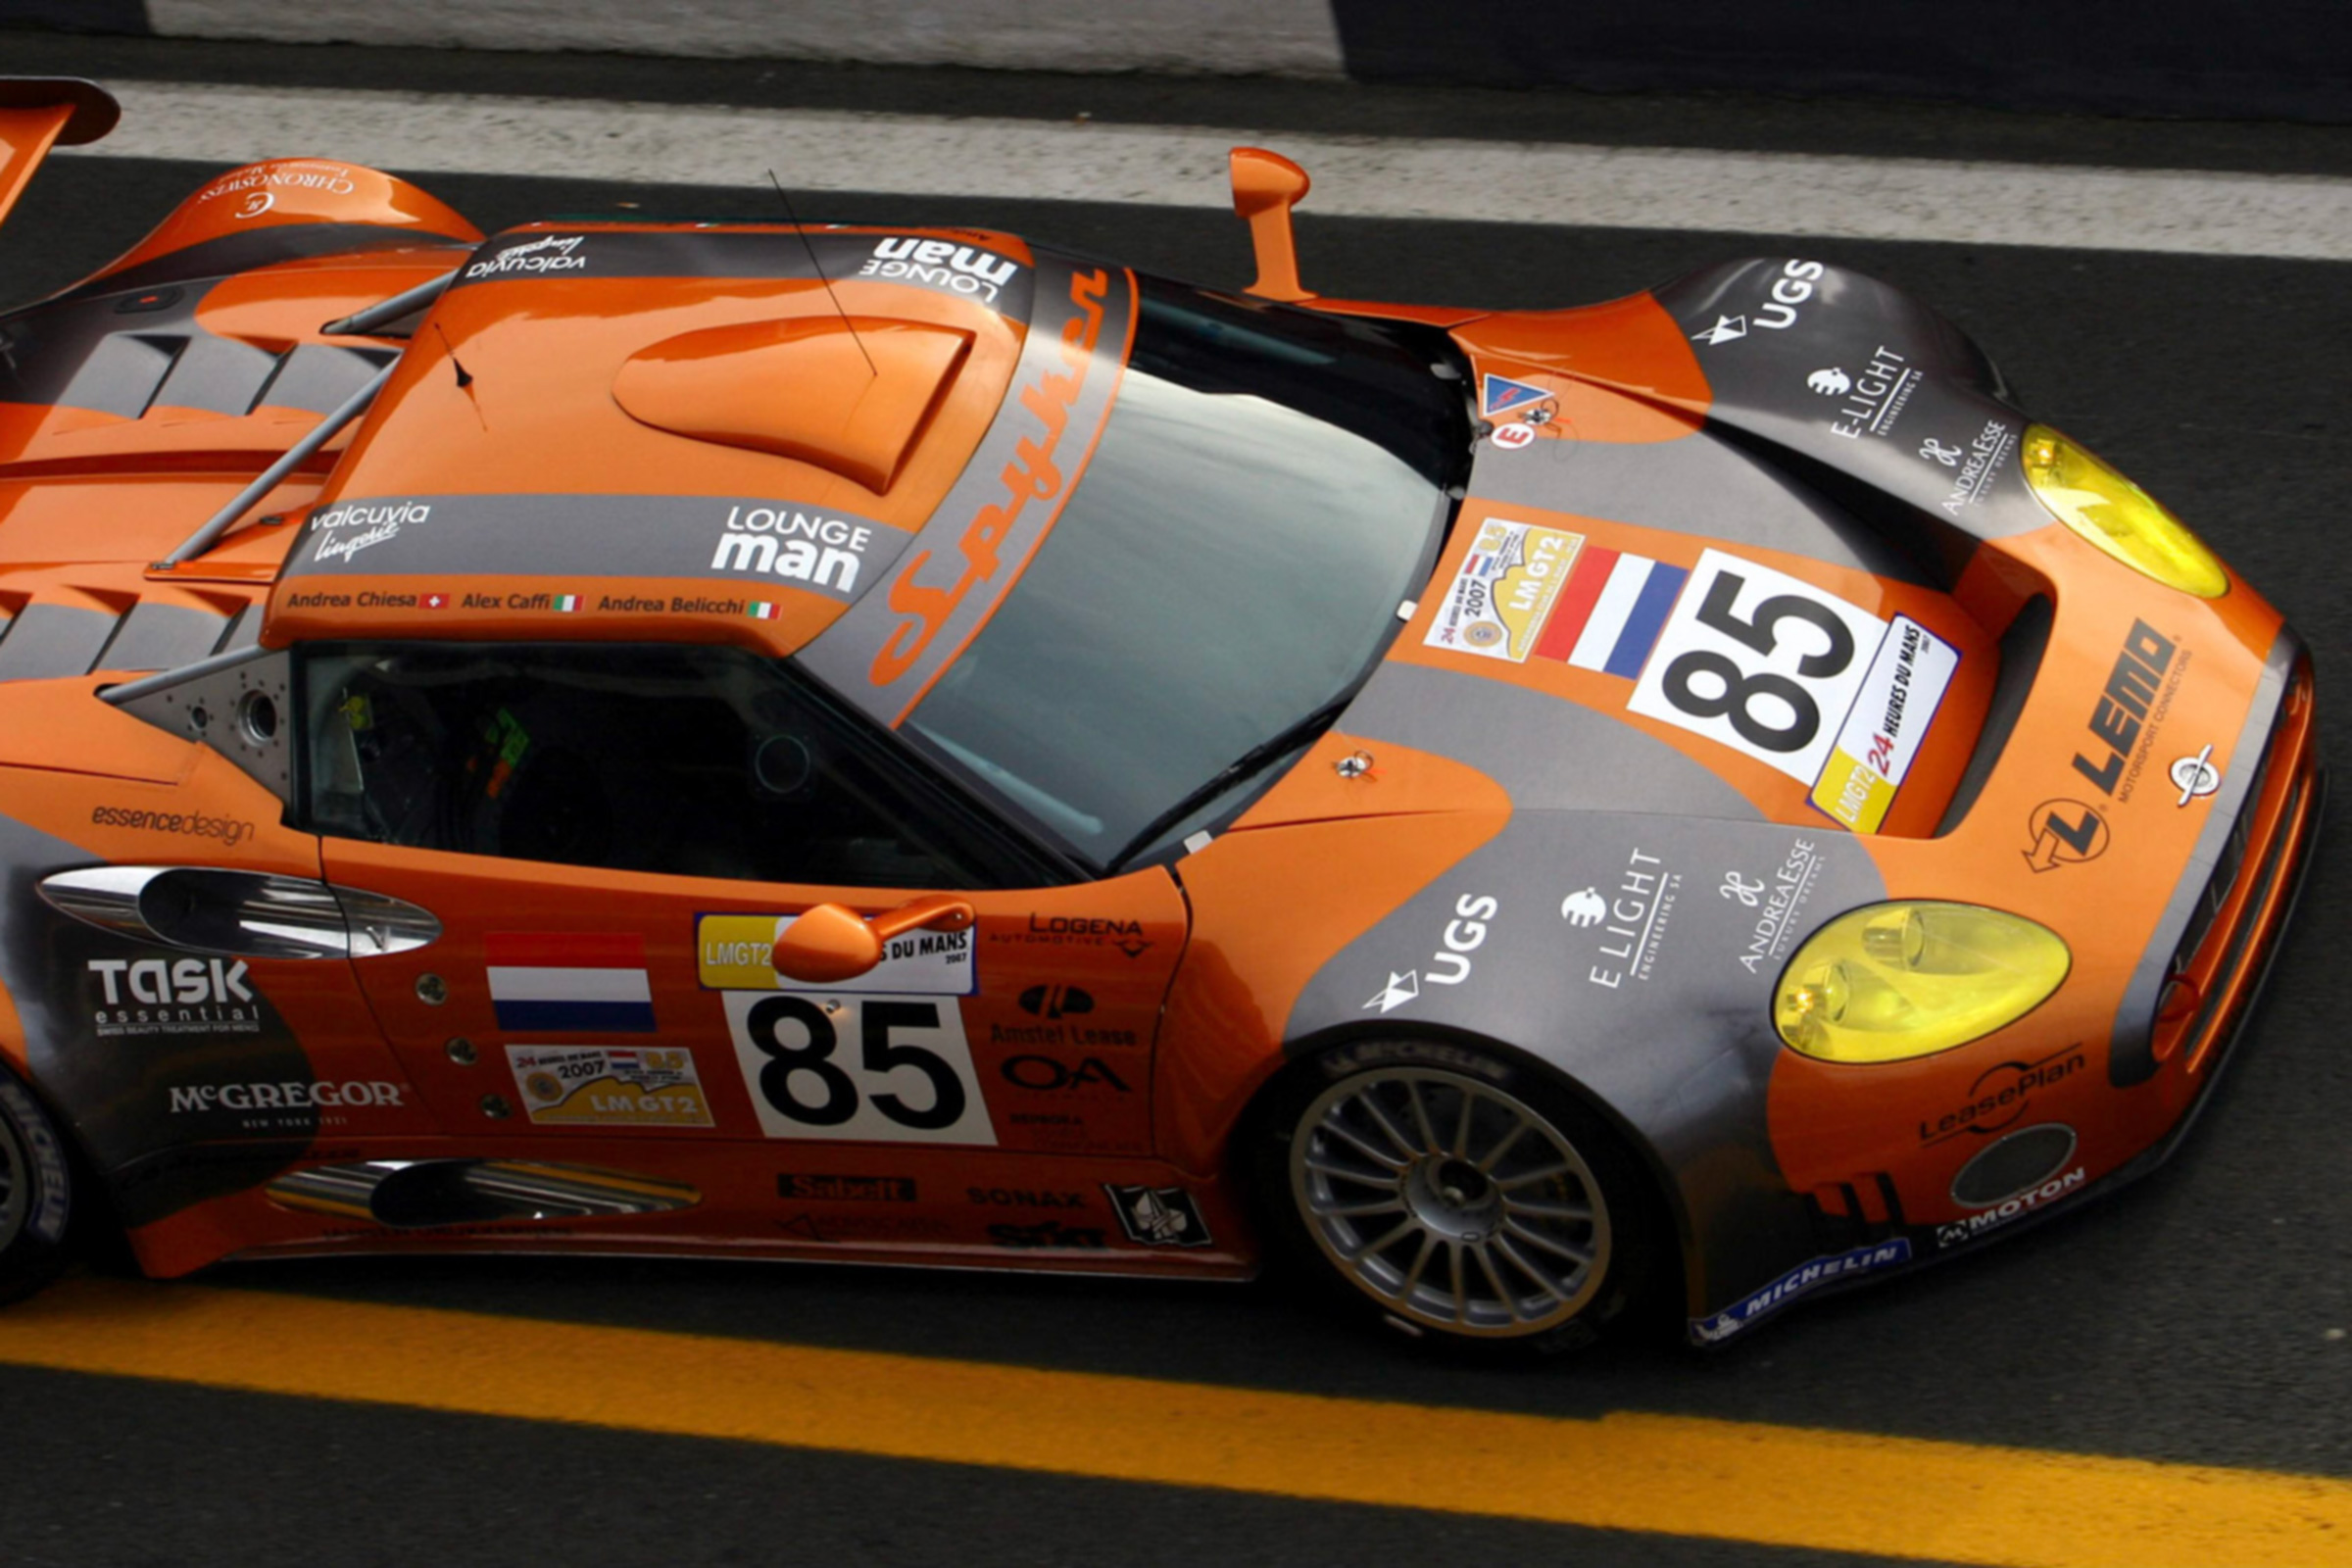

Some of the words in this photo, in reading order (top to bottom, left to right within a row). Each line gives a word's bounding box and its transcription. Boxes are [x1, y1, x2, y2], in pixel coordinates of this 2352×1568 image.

[466, 256, 586, 279] valcuvia
[858, 259, 999, 304] LOUNGE
[873, 237, 1017, 286] man
[1753, 258, 1825, 330] UGS
[1832, 346, 1907, 440] E-LIGHT
[311, 501, 431, 531] valcuvia
[727, 506, 872, 552] LOUNGE
[710, 533, 860, 594] man
[287, 593, 351, 608] Andrea
[357, 592, 417, 608] Chiesa
[462, 594, 501, 609] Alex
[507, 594, 551, 609] Caffi
[598, 596, 664, 612] Andrea
[670, 597, 745, 614] Belicchi
[1464, 578, 1487, 617] 2007
[1441, 628, 1456, 645] 24
[1899, 624, 1921, 668] MANS
[1662, 569, 1855, 754] 85
[1893, 664, 1913, 687] DU
[1883, 685, 1907, 738] HEURES
[2071, 617, 2178, 797] LEMO
[2118, 722, 2160, 805] MOTORSPORT
[2153, 648, 2192, 723] CONNECTORS
[1868, 733, 1894, 776] 24
[1834, 764, 1877, 823] LMGT2
[892, 941, 914, 959] DU
[919, 932, 967, 956] MANS
[1030, 912, 1142, 935] LOGENA
[1425, 893, 1498, 986] UGS
[1638, 894, 1674, 981] ENGINEERING
[1668, 873, 1683, 894] SA
[705, 942, 771, 966] LMGT2
[96, 1004, 260, 1024] essential
[991, 1022, 1065, 1046] Amstel
[1071, 1025, 1137, 1047] Lease
[559, 1060, 606, 1079] 2007
[748, 996, 965, 1130] 85
[1920, 1053, 2085, 1141] LeasePlan
[1969, 1165, 2085, 1231] MOTON
[1746, 1246, 1897, 1318] MICHELIN
